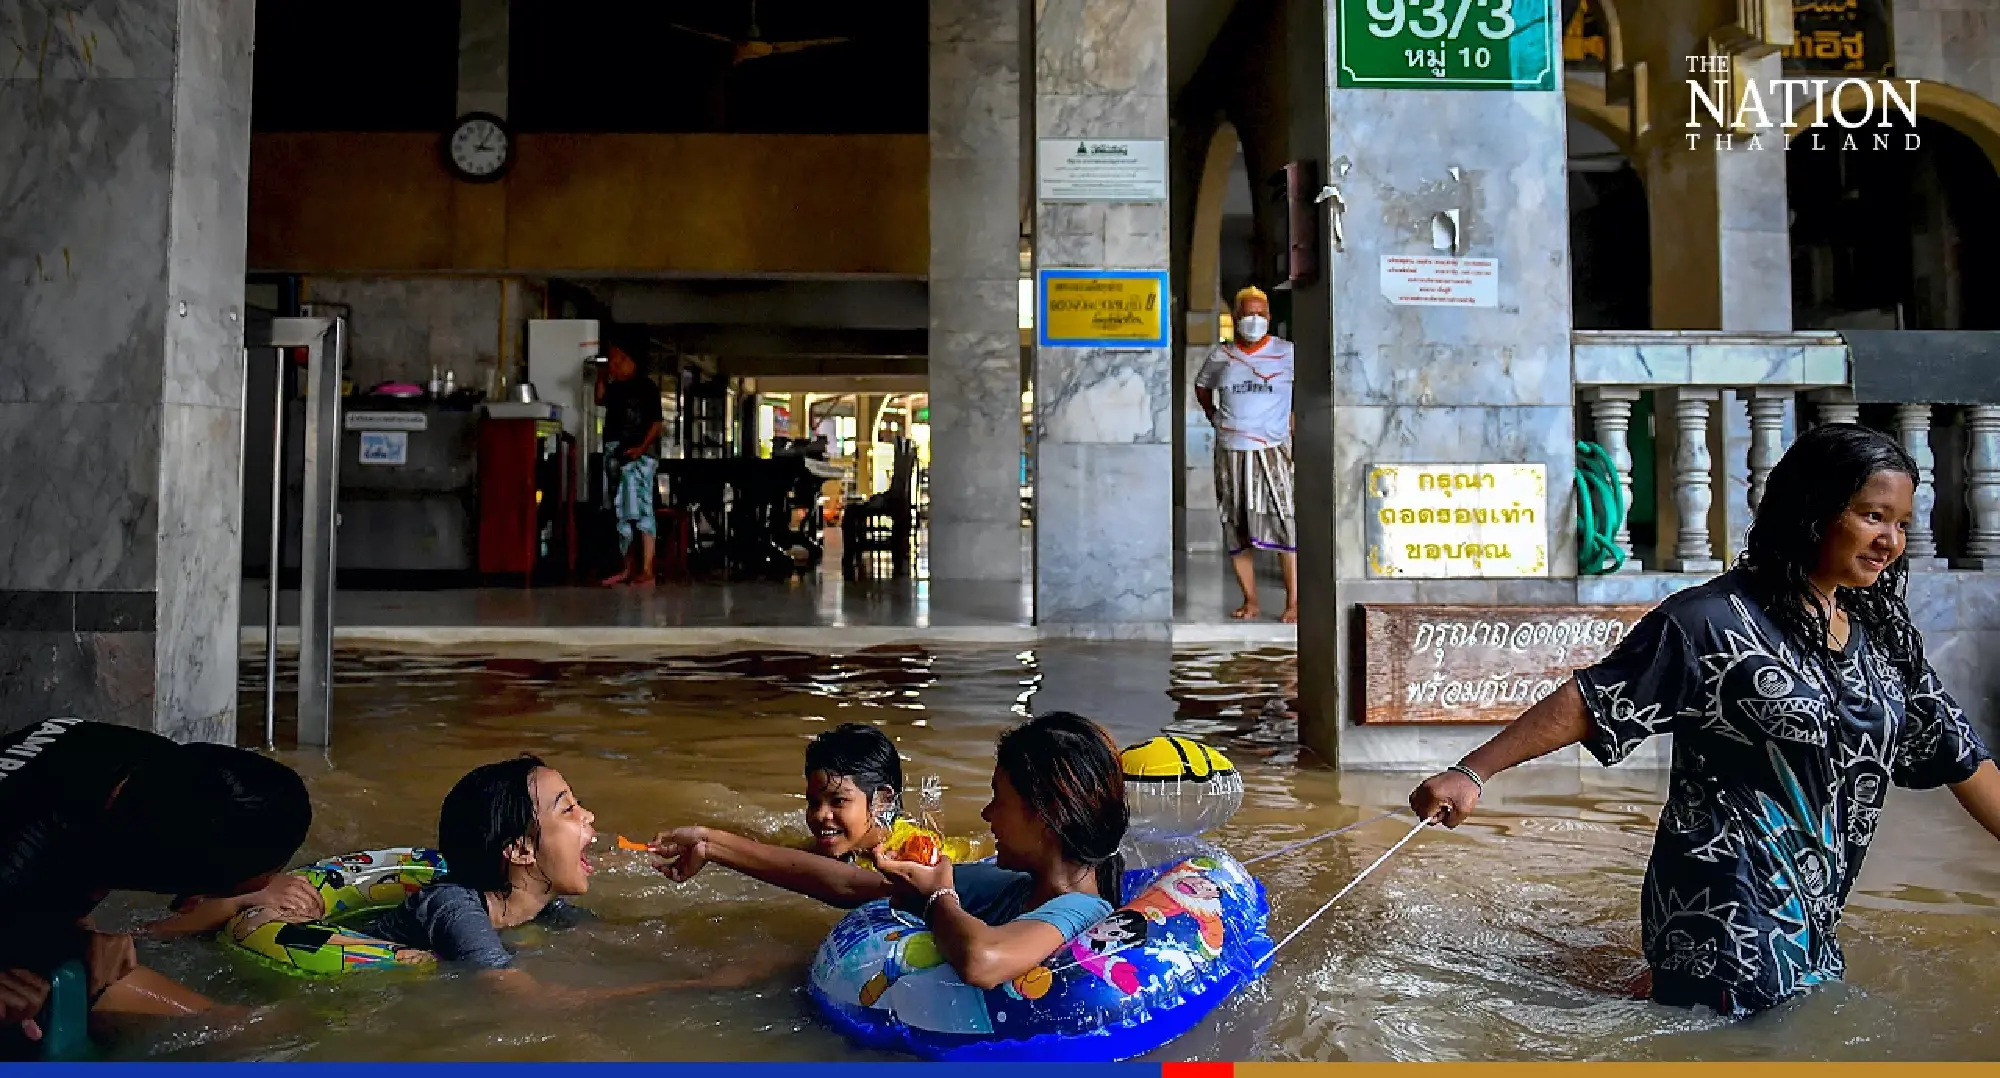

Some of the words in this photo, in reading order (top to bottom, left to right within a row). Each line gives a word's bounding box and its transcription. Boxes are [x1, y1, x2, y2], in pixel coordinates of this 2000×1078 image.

[1366, 0, 1515, 39] 93/3
[1405, 41, 1445, 77] หมู่
[1458, 47, 1491, 67] 10
[1418, 473, 1495, 498] กรุณา
[1379, 501, 1535, 524] ถอดรองเท้า
[1406, 542, 1512, 569] ขอบคุณ
